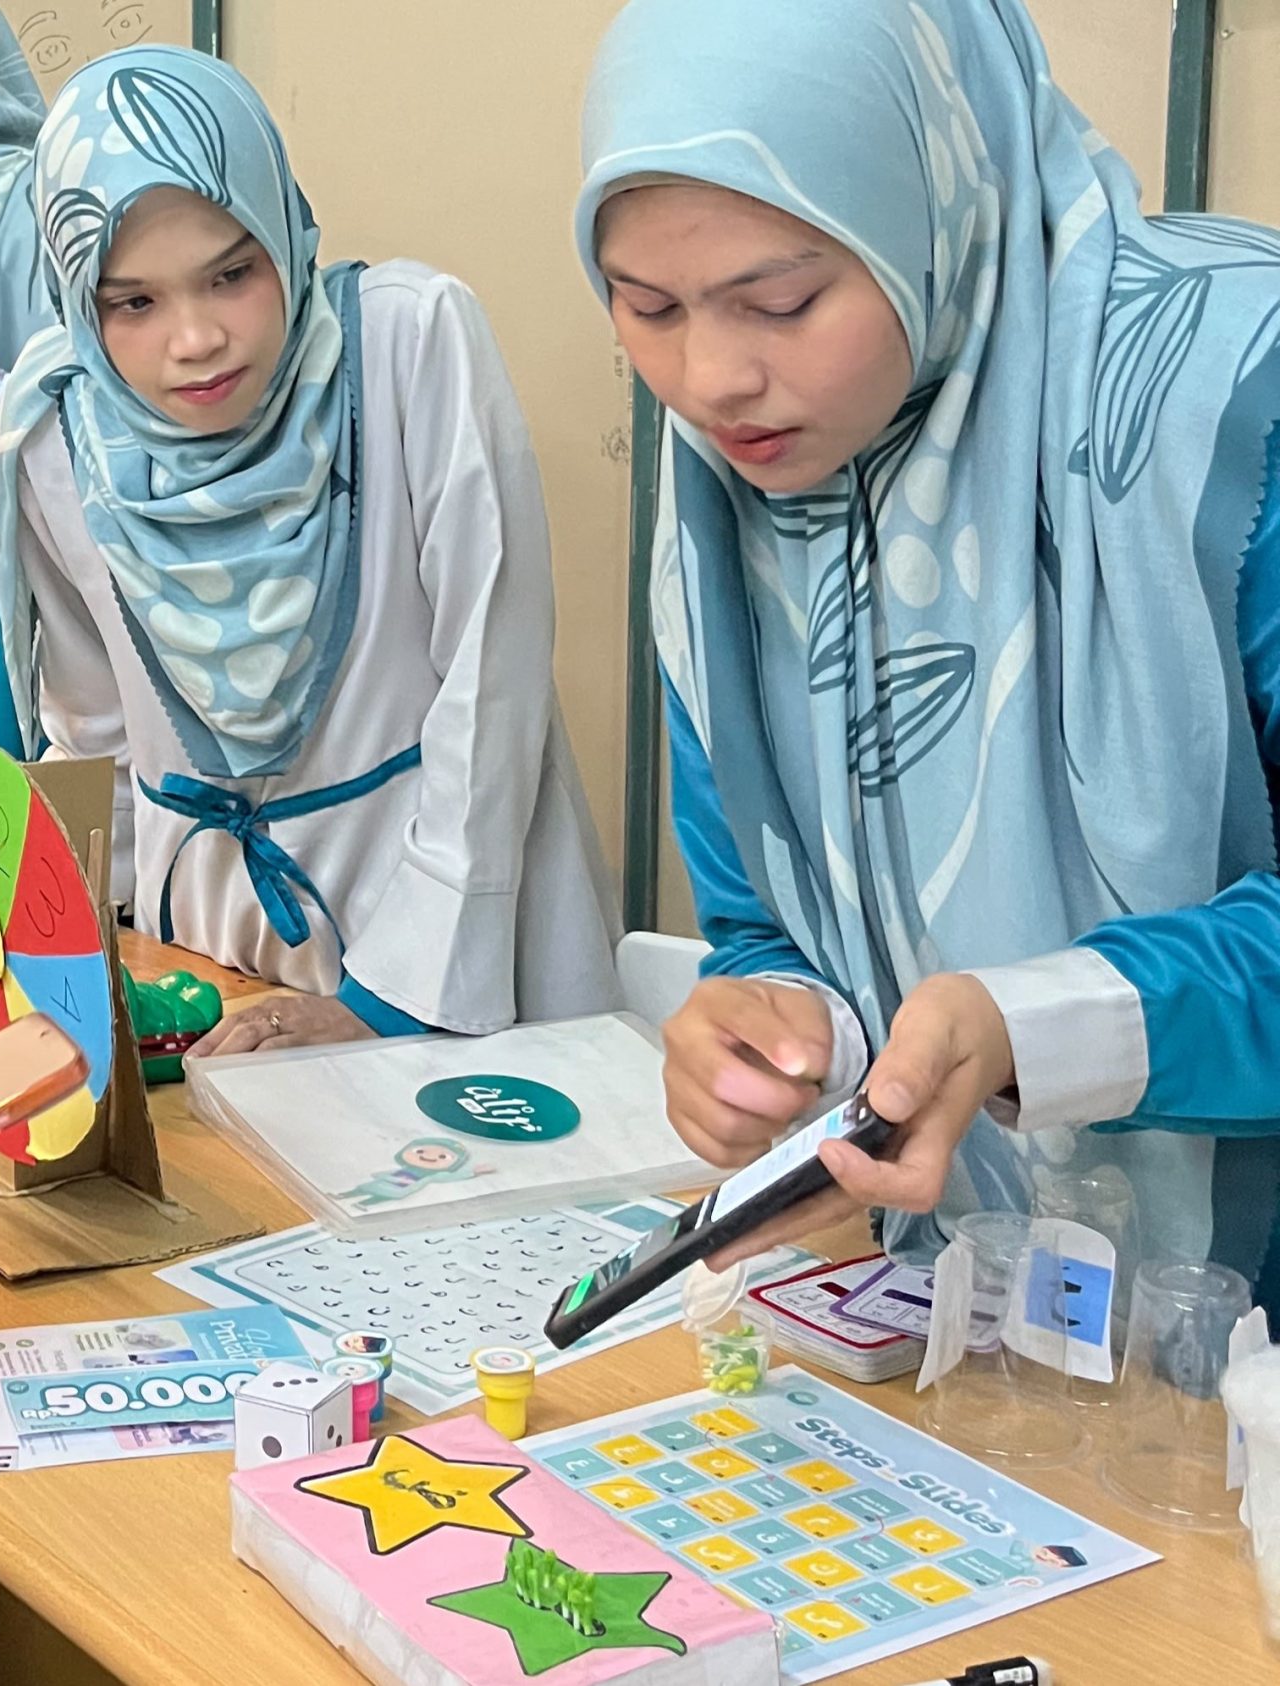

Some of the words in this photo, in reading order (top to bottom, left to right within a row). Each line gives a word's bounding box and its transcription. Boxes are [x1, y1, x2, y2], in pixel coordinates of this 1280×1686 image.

[24, 855, 67, 939] 3
[794, 1416, 891, 1471] Steps
[898, 1473, 1011, 1535] Slides
